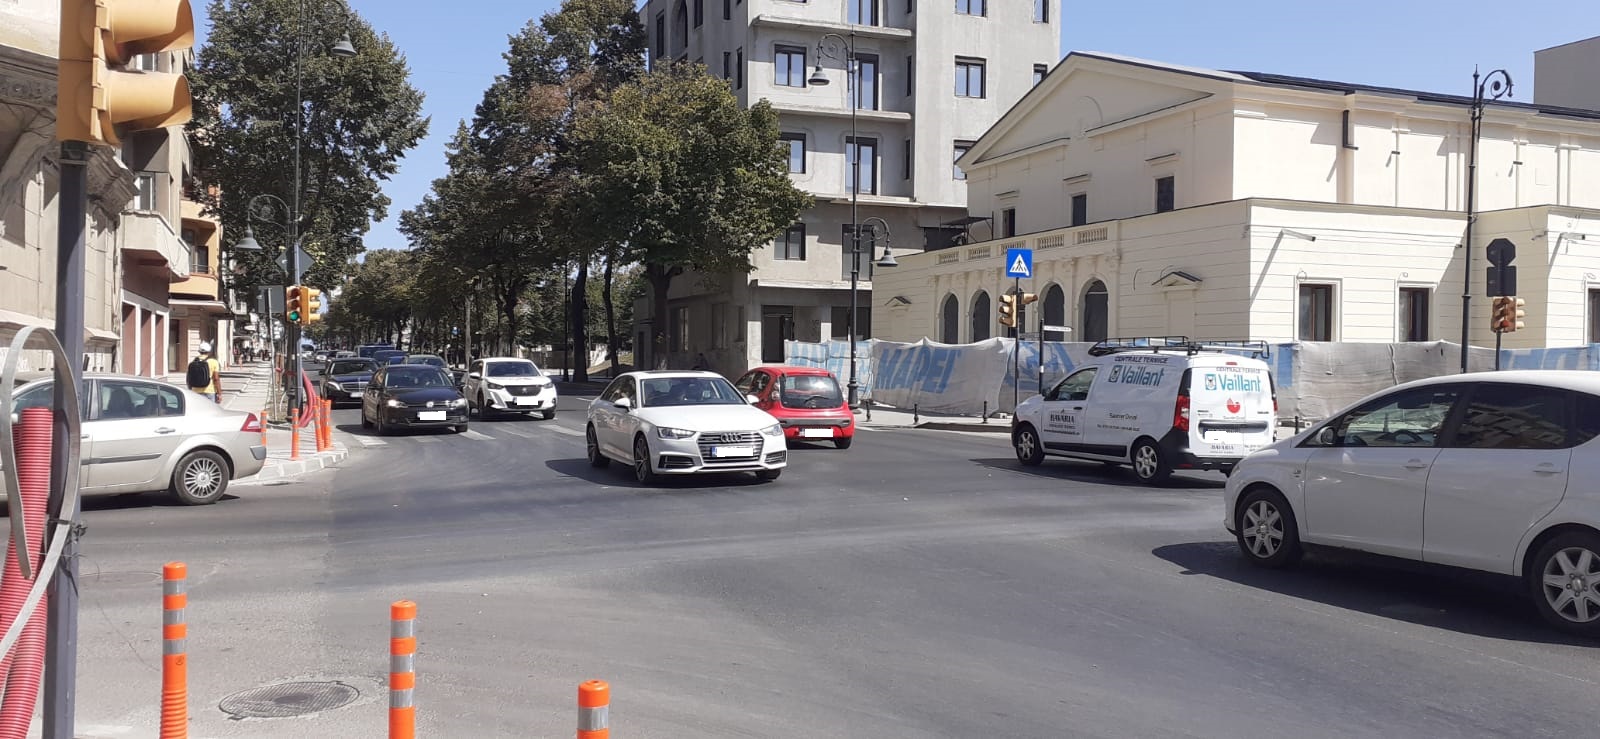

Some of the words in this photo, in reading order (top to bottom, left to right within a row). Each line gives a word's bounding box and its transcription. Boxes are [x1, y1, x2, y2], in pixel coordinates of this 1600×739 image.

[875, 347, 961, 394] MAPEI
[1120, 365, 1165, 387] Vaillant
[1218, 373, 1261, 392] Vaillant
